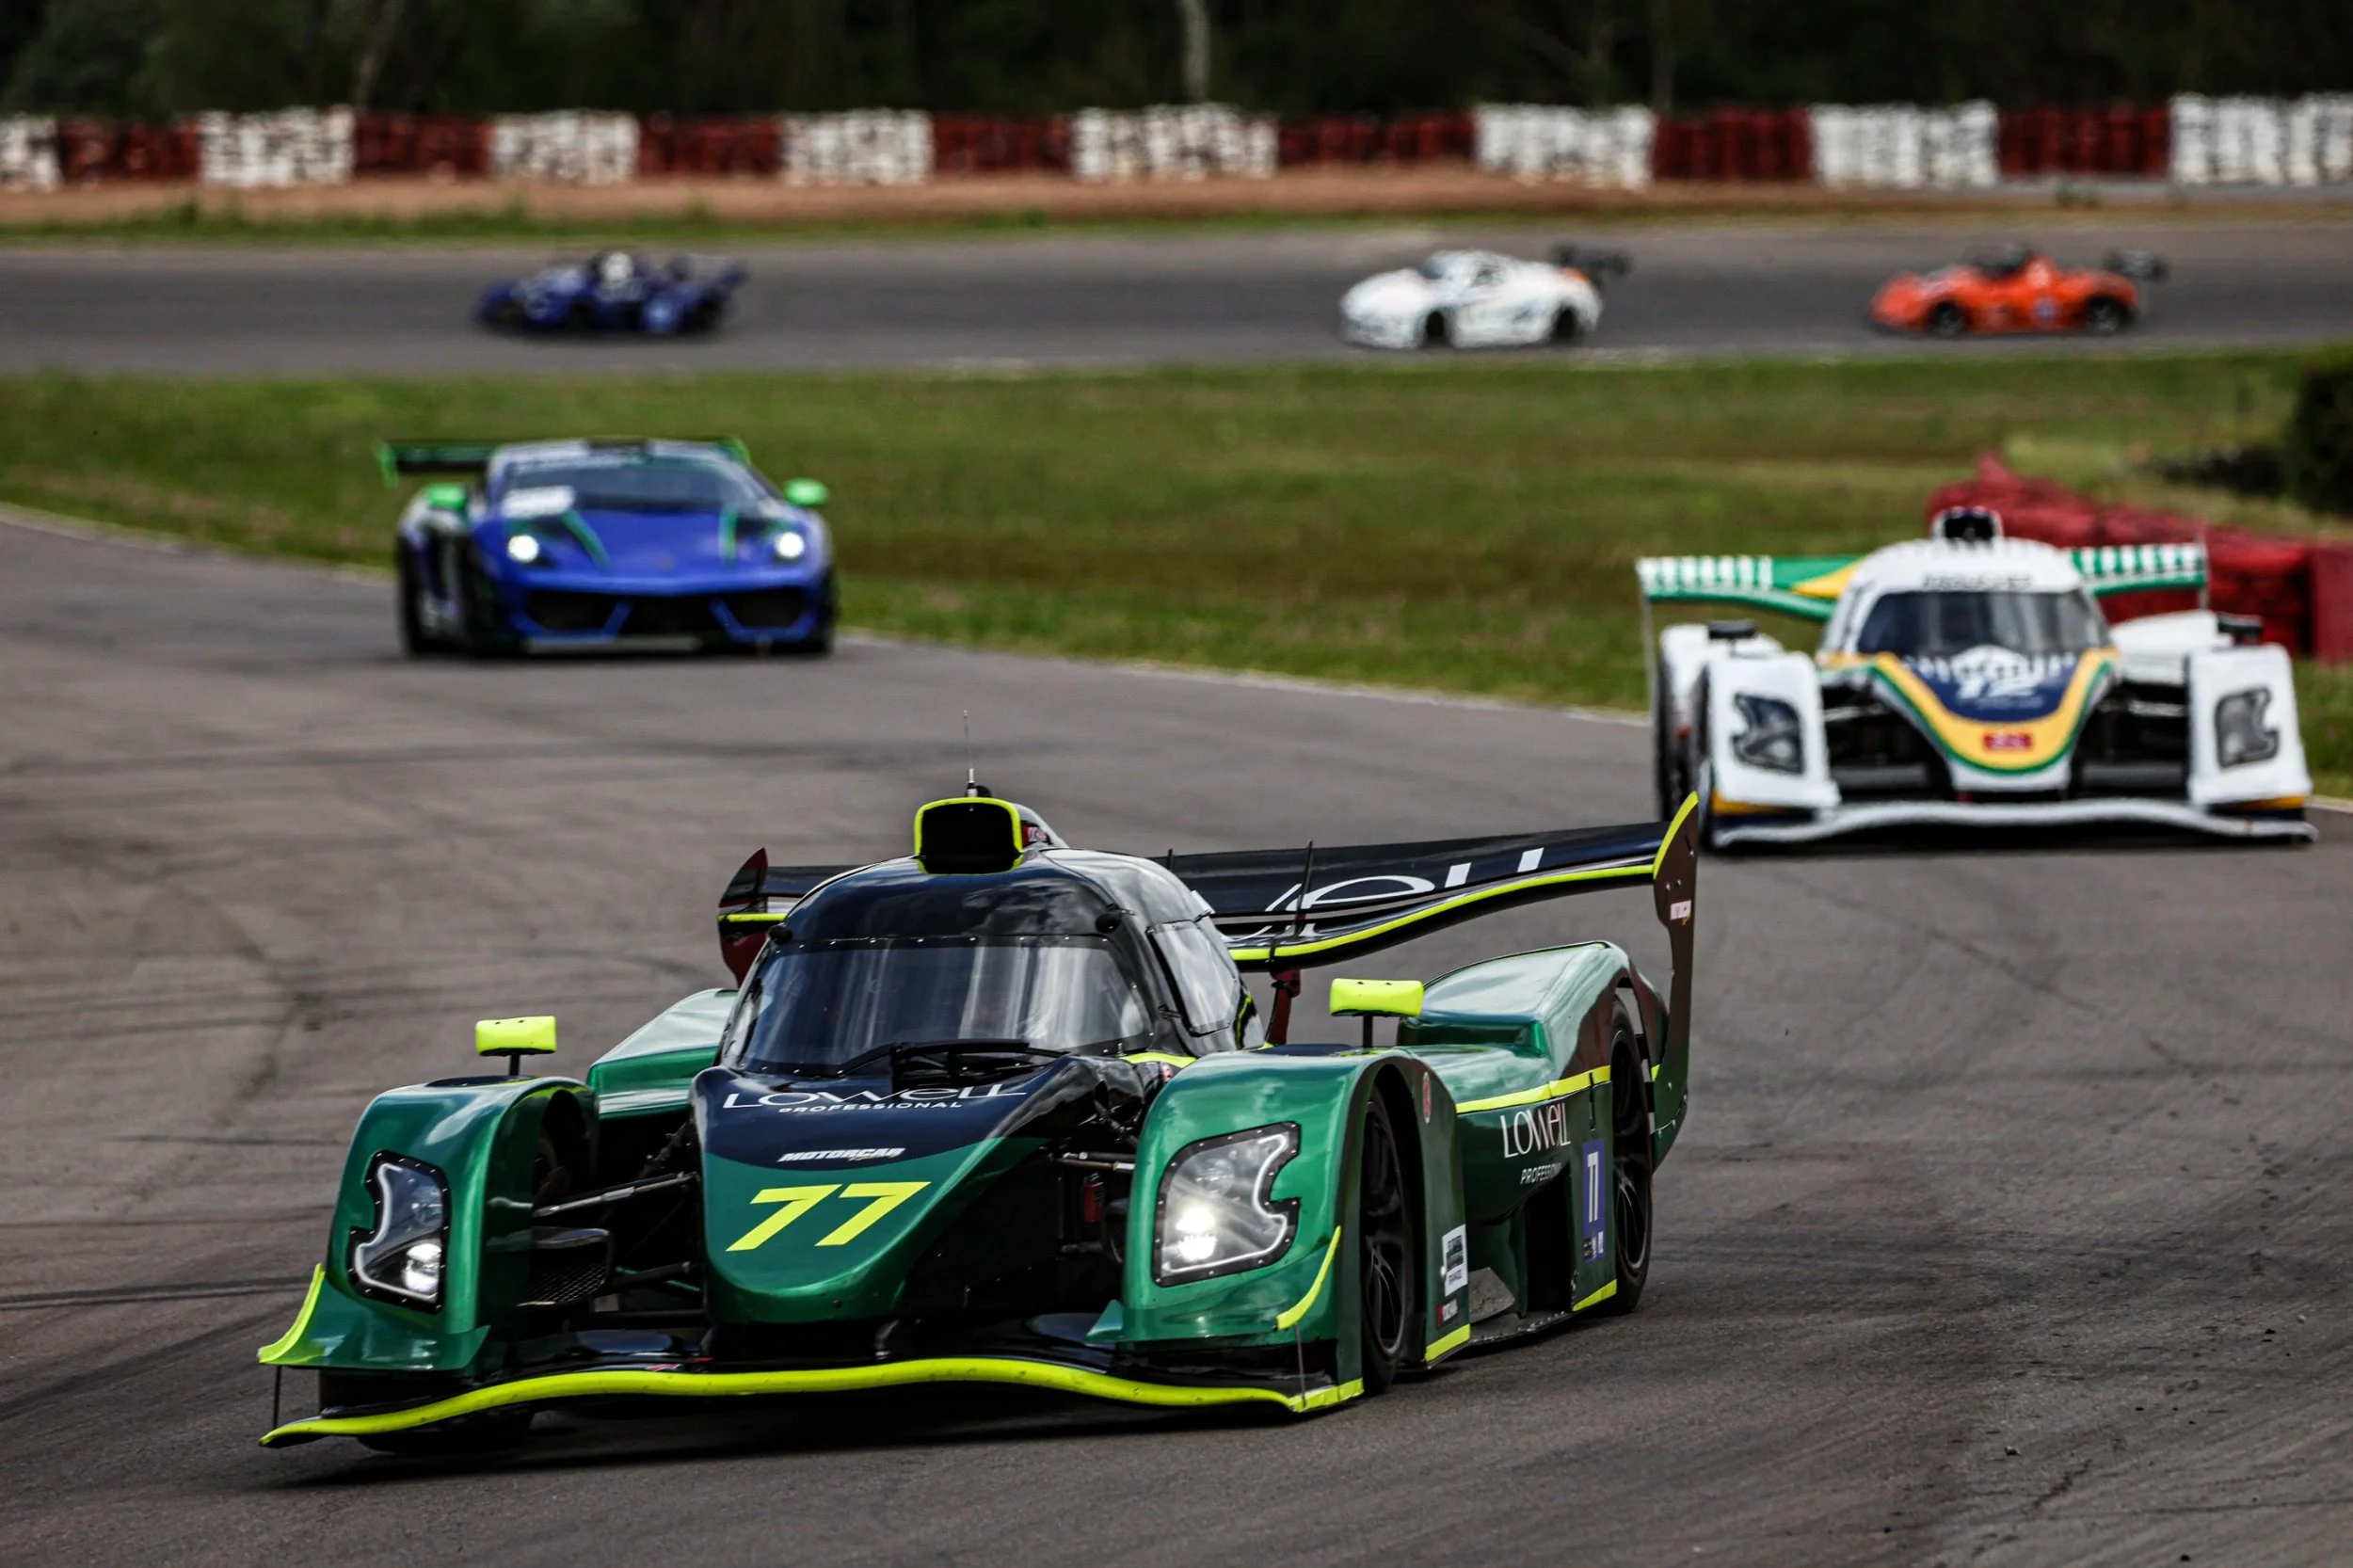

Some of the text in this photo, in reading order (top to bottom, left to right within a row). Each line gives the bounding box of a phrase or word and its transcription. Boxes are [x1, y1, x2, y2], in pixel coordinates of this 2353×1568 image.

[778, 1101, 963, 1113] PROFESSIONAL
[776, 1148, 905, 1161] MOTORCAR
[725, 1182, 932, 1252] 77
